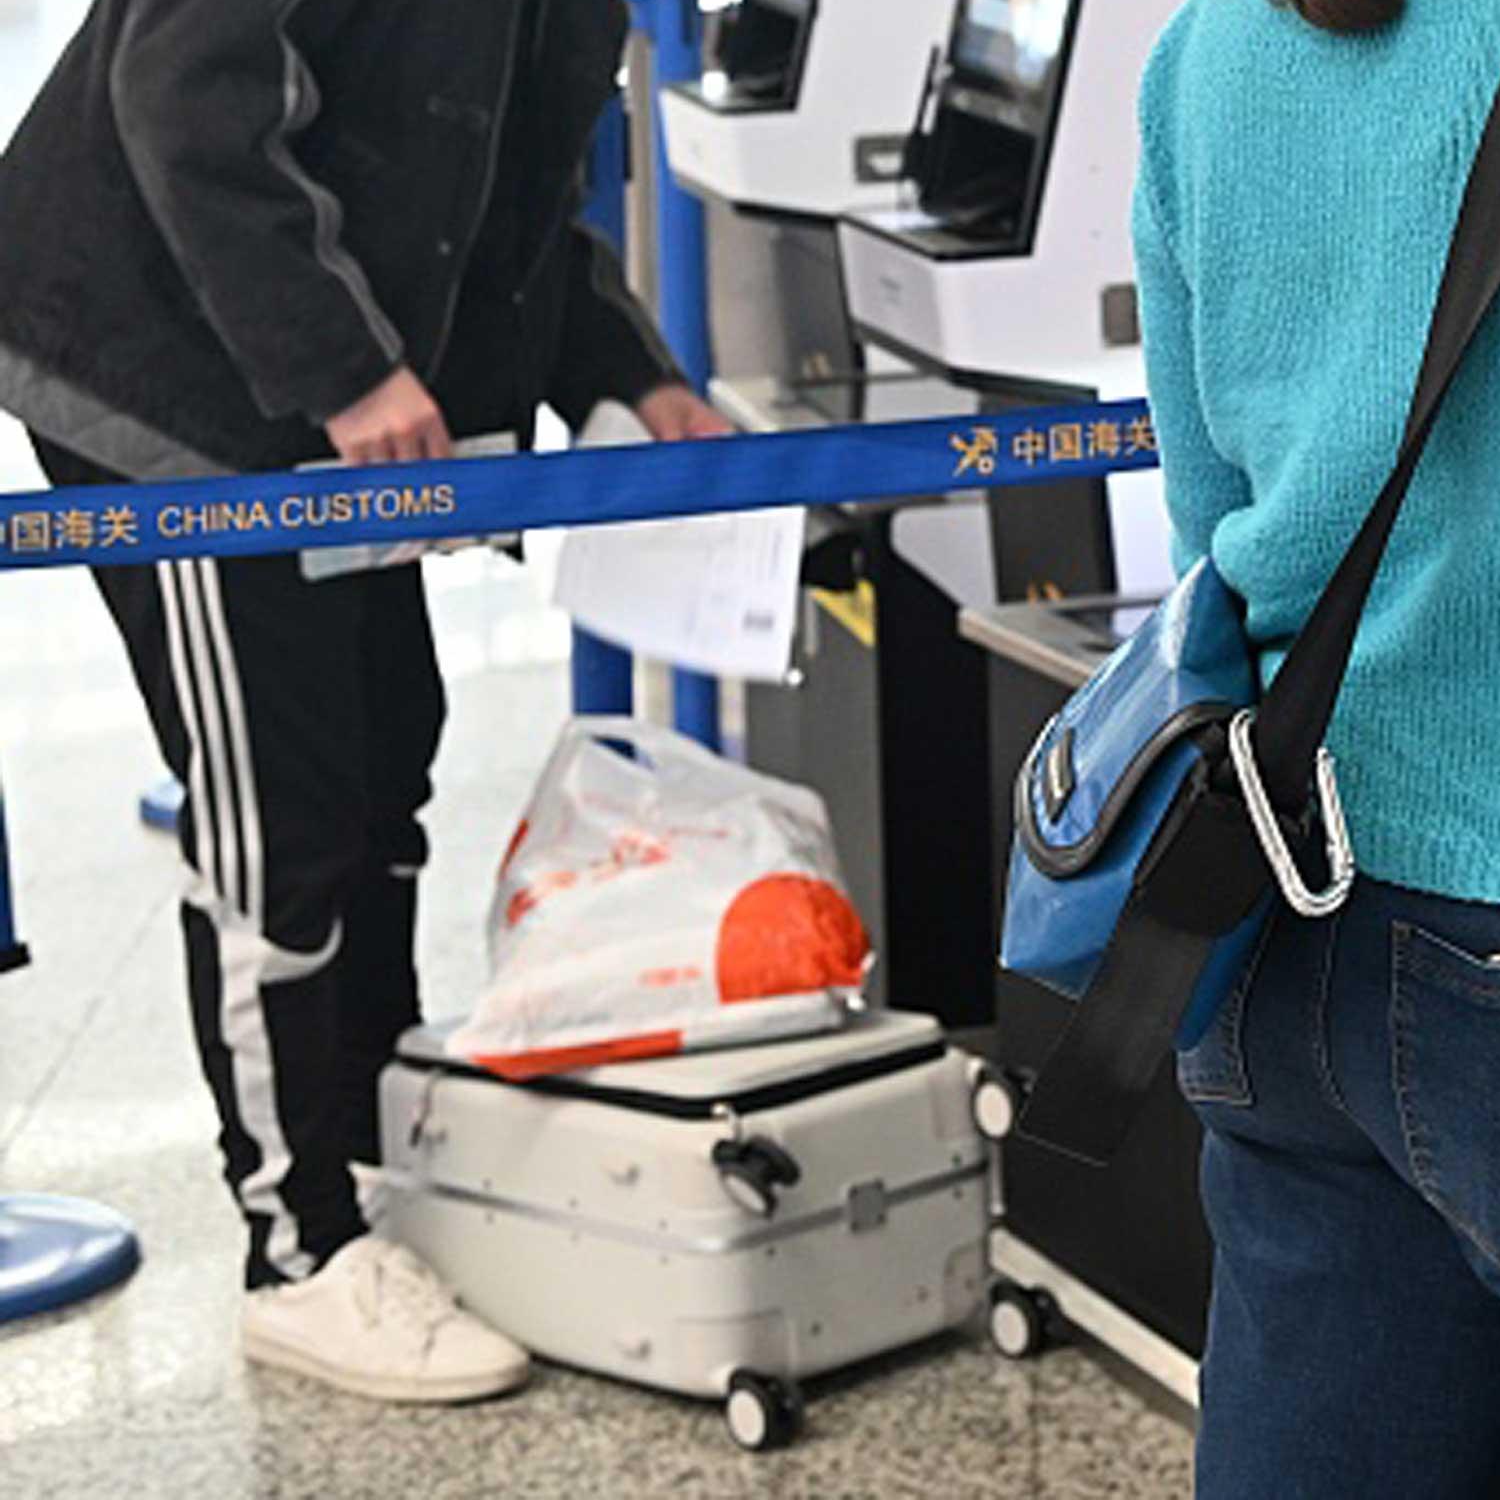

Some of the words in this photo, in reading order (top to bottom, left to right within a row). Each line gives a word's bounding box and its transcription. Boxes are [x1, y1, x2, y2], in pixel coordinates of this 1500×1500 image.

[1012, 415, 1158, 467] 中国海关
[0, 505, 139, 553] 国海关
[157, 501, 272, 538] CHINA
[279, 484, 457, 528] CUSTOMS
